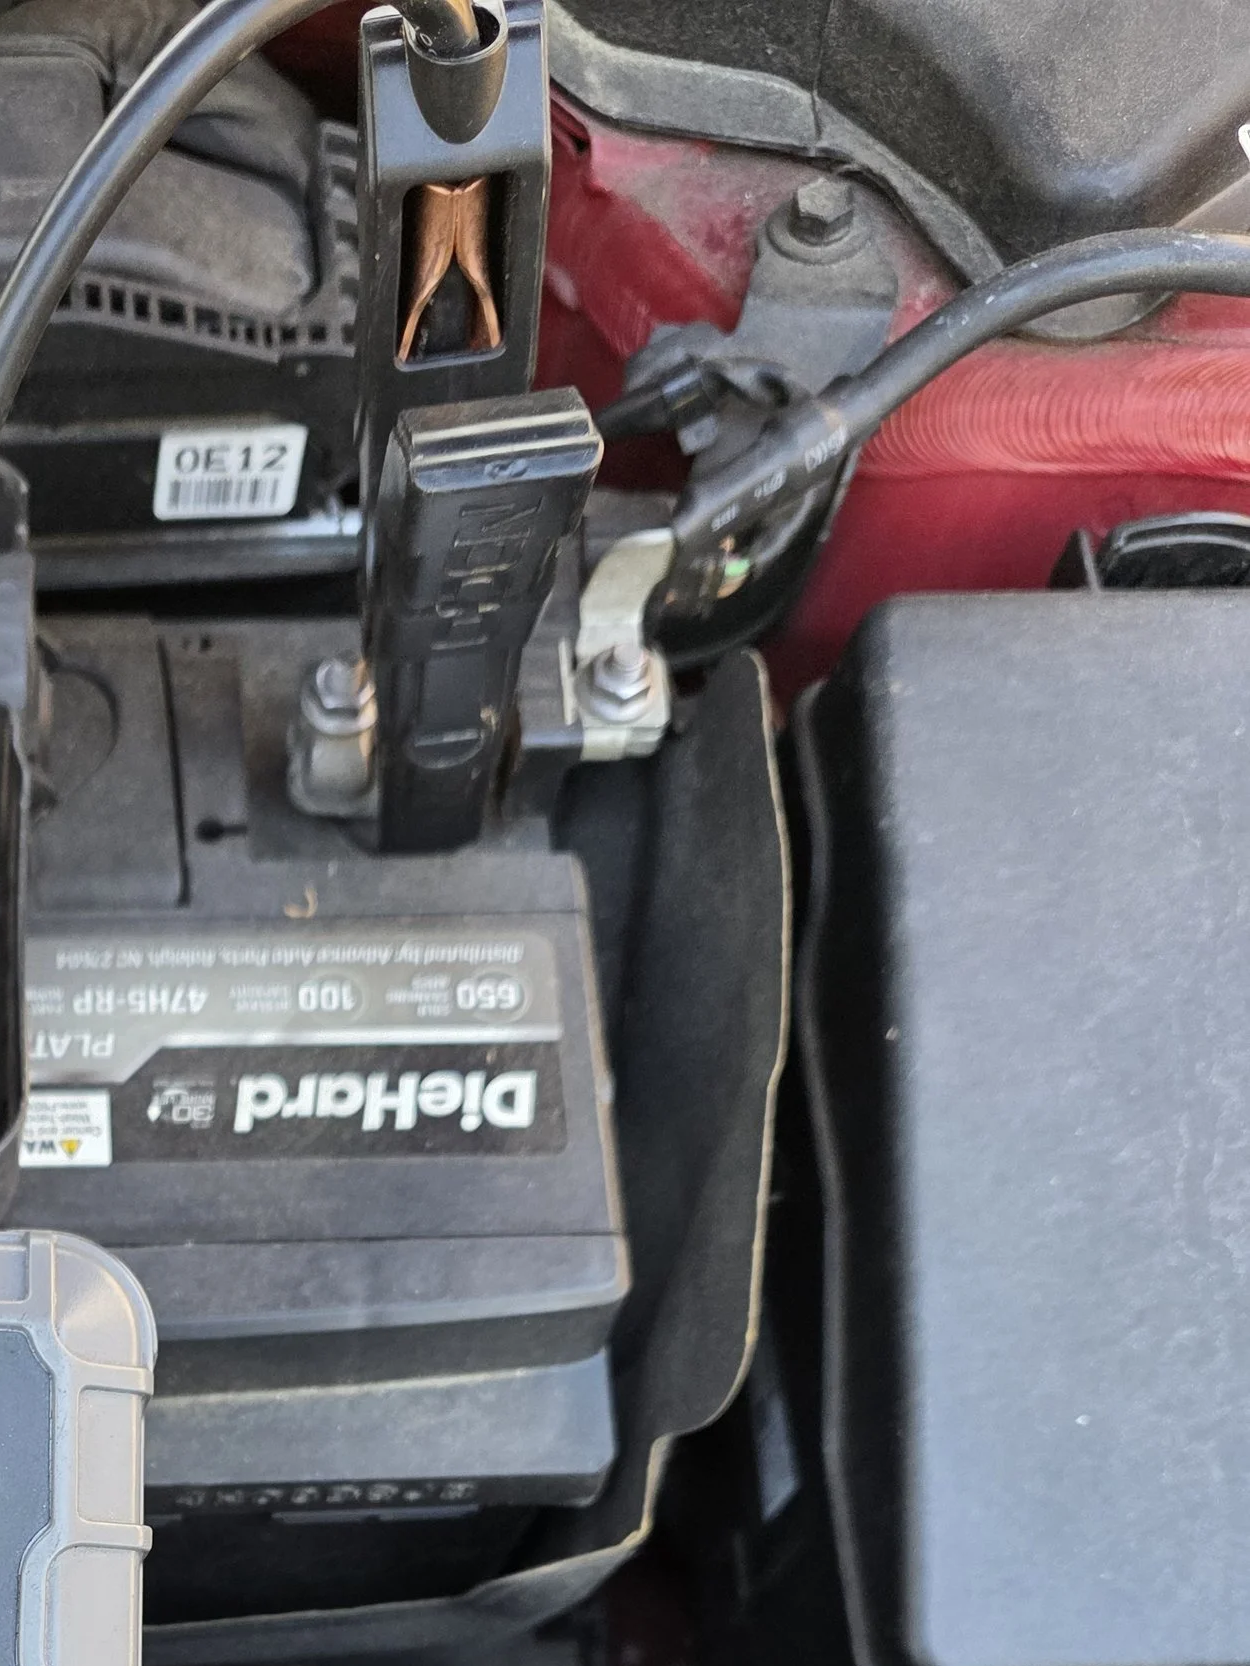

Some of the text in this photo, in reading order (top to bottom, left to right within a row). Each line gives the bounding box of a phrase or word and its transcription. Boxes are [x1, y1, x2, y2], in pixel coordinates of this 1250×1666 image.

[72, 983, 210, 1015] 47H5-RP
[298, 979, 356, 1013] 100
[456, 977, 522, 1011] 650
[233, 1070, 538, 1133] DieHard
